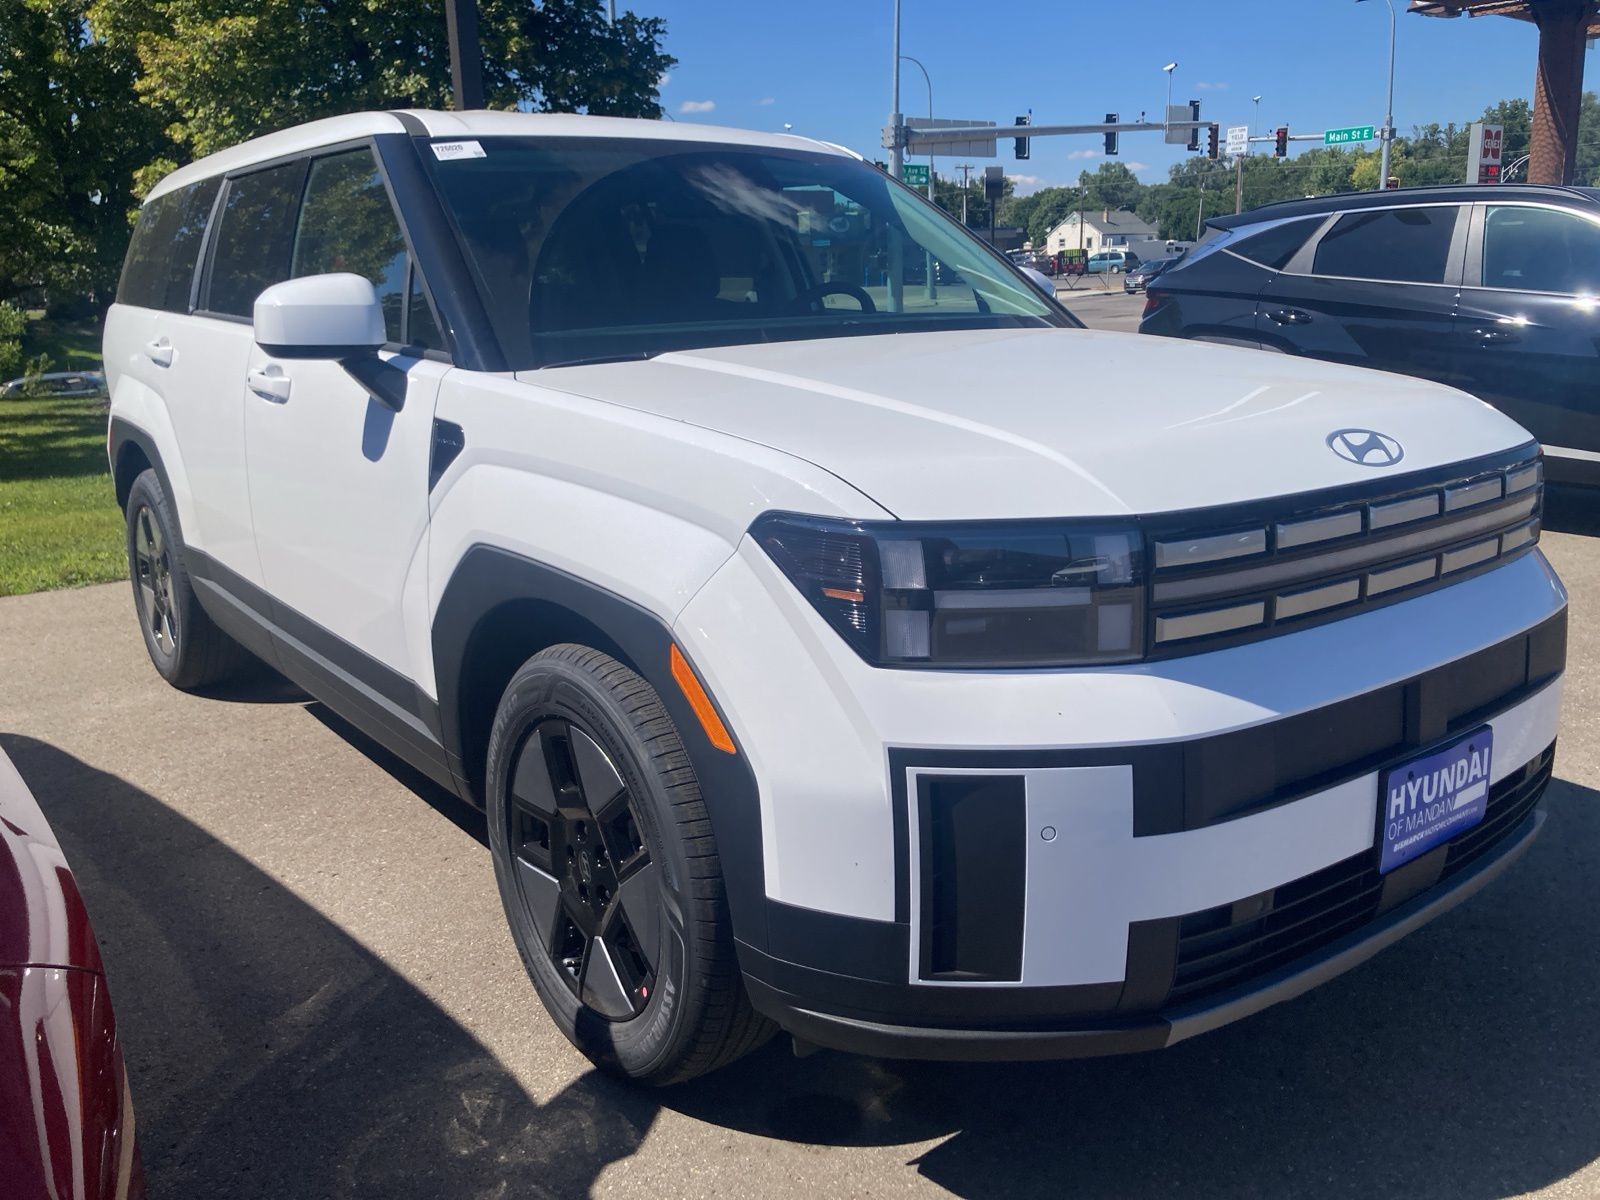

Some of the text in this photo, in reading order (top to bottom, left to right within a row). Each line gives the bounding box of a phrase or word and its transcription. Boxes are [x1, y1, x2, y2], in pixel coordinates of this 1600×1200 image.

[1329, 128, 1369, 142] Main St E
[1390, 748, 1489, 819] HYUNDAI
[1388, 796, 1456, 841] OF MANDAN
